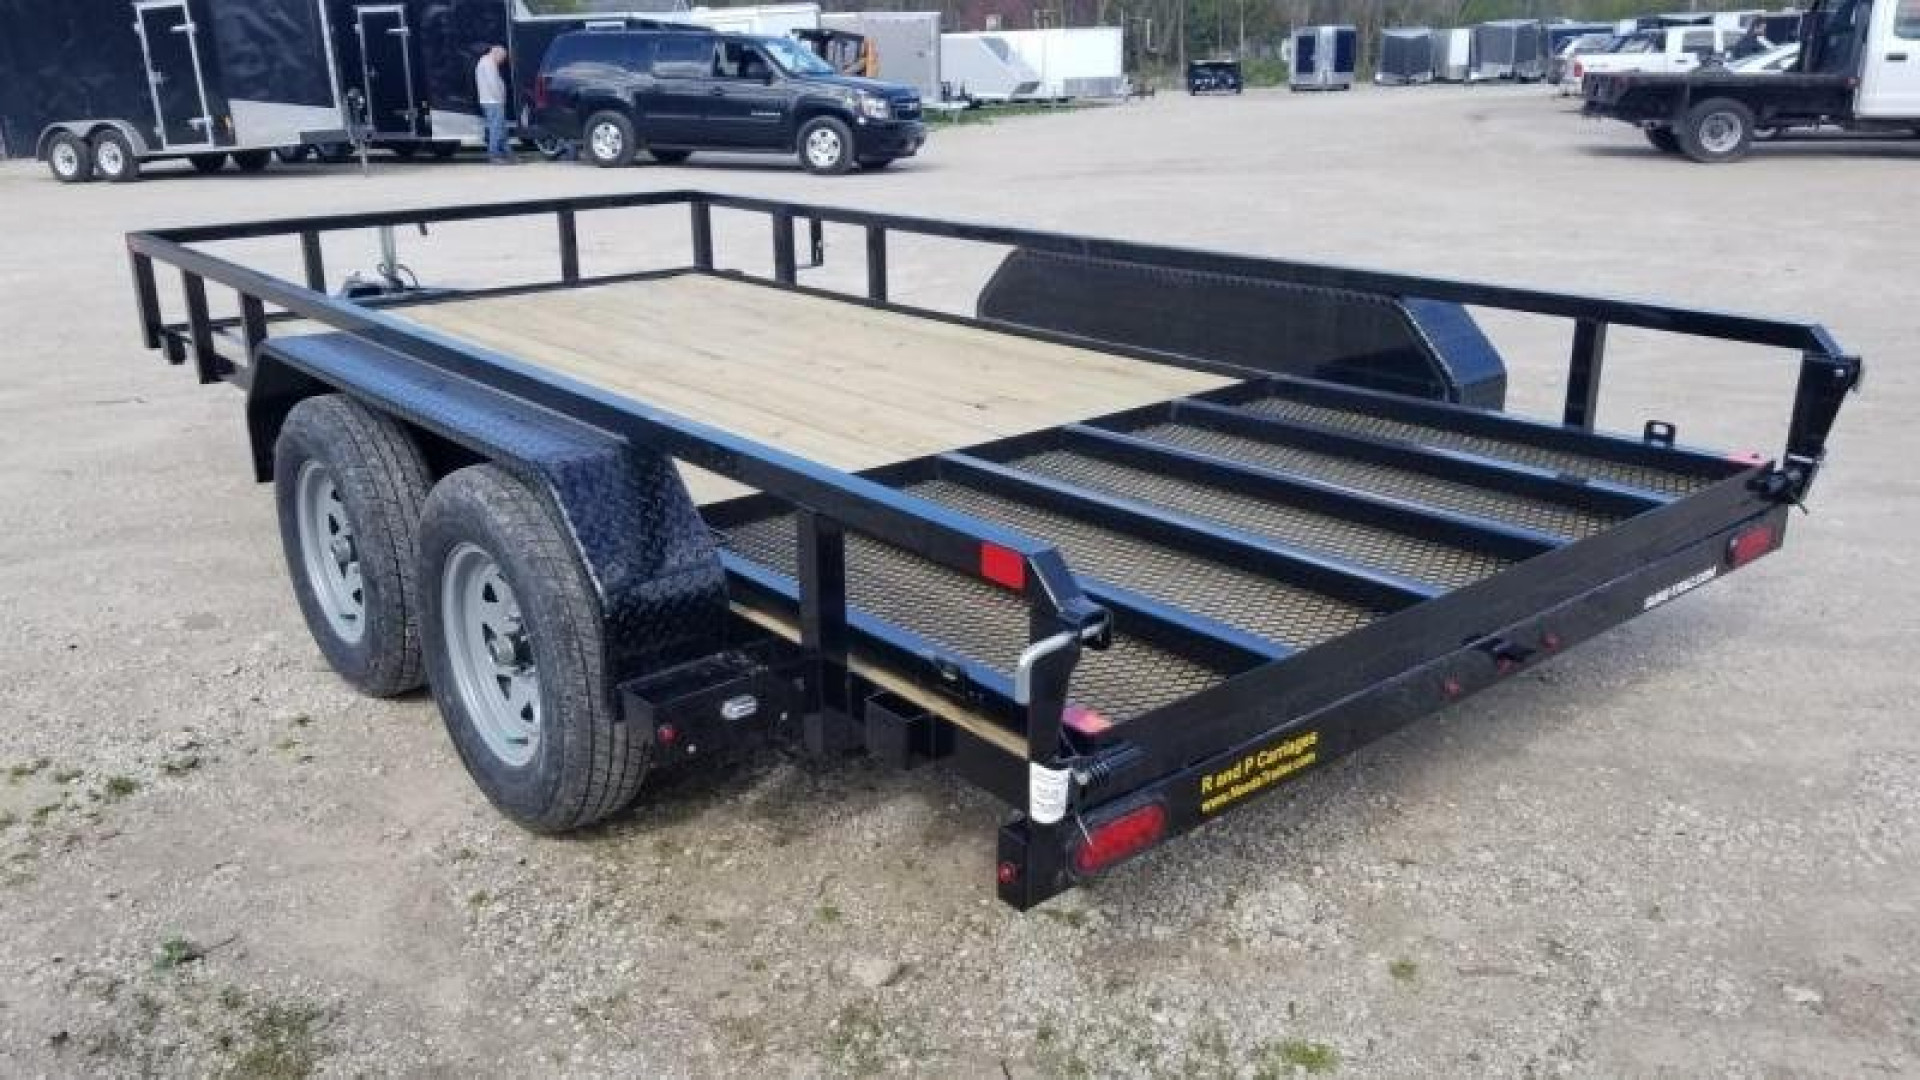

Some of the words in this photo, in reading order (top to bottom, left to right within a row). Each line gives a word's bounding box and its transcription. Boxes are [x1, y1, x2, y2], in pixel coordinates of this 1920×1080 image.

[1201, 774, 1213, 795] R
[1216, 762, 1242, 787] and
[1245, 756, 1254, 774] P
[1257, 731, 1319, 768] Carriages
